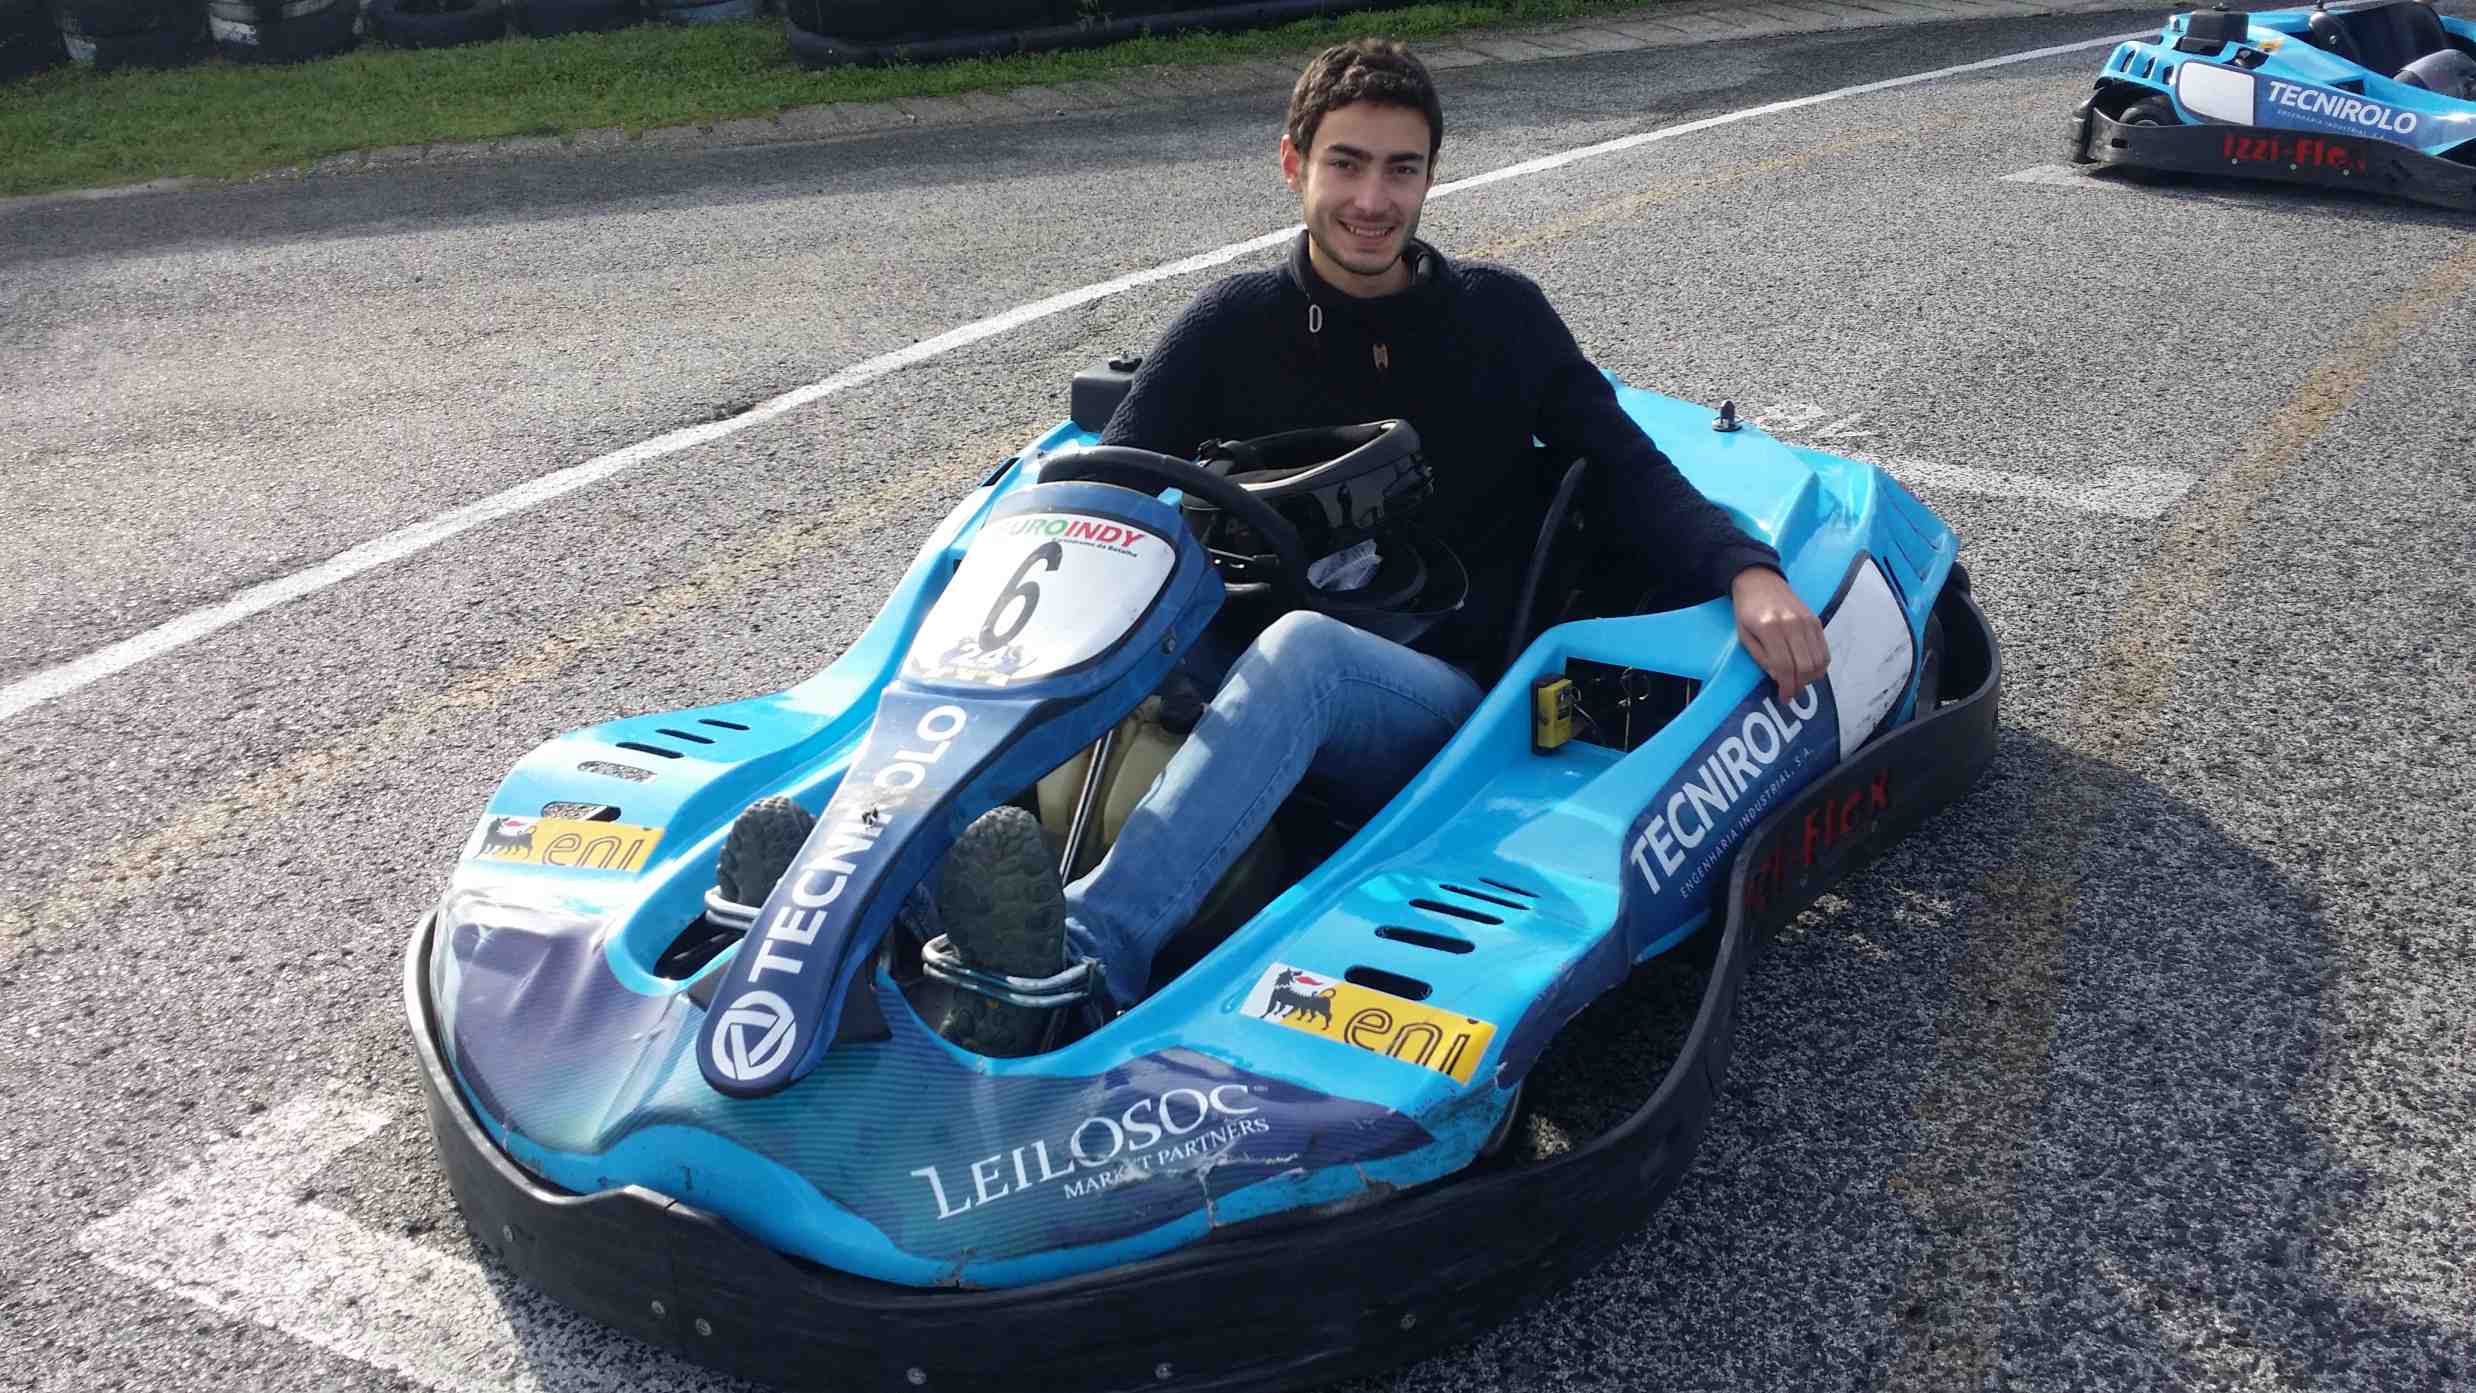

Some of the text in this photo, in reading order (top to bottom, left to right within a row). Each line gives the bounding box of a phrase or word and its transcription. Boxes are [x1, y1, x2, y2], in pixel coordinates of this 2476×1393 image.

[2267, 80, 2417, 134] TECNIROLO
[1006, 518, 1145, 548] UROINDY
[978, 540, 1063, 652] 6
[1630, 683, 1819, 896] TECNIROLO
[542, 827, 652, 871] eni
[747, 704, 968, 984] TECNIOLO
[1680, 828, 1739, 899] ENGENHARIA
[1343, 1008, 1480, 1076] eni
[911, 1083, 1259, 1221] LEILOSOC
[1064, 1117, 1270, 1200] MARKT PARTNERS
